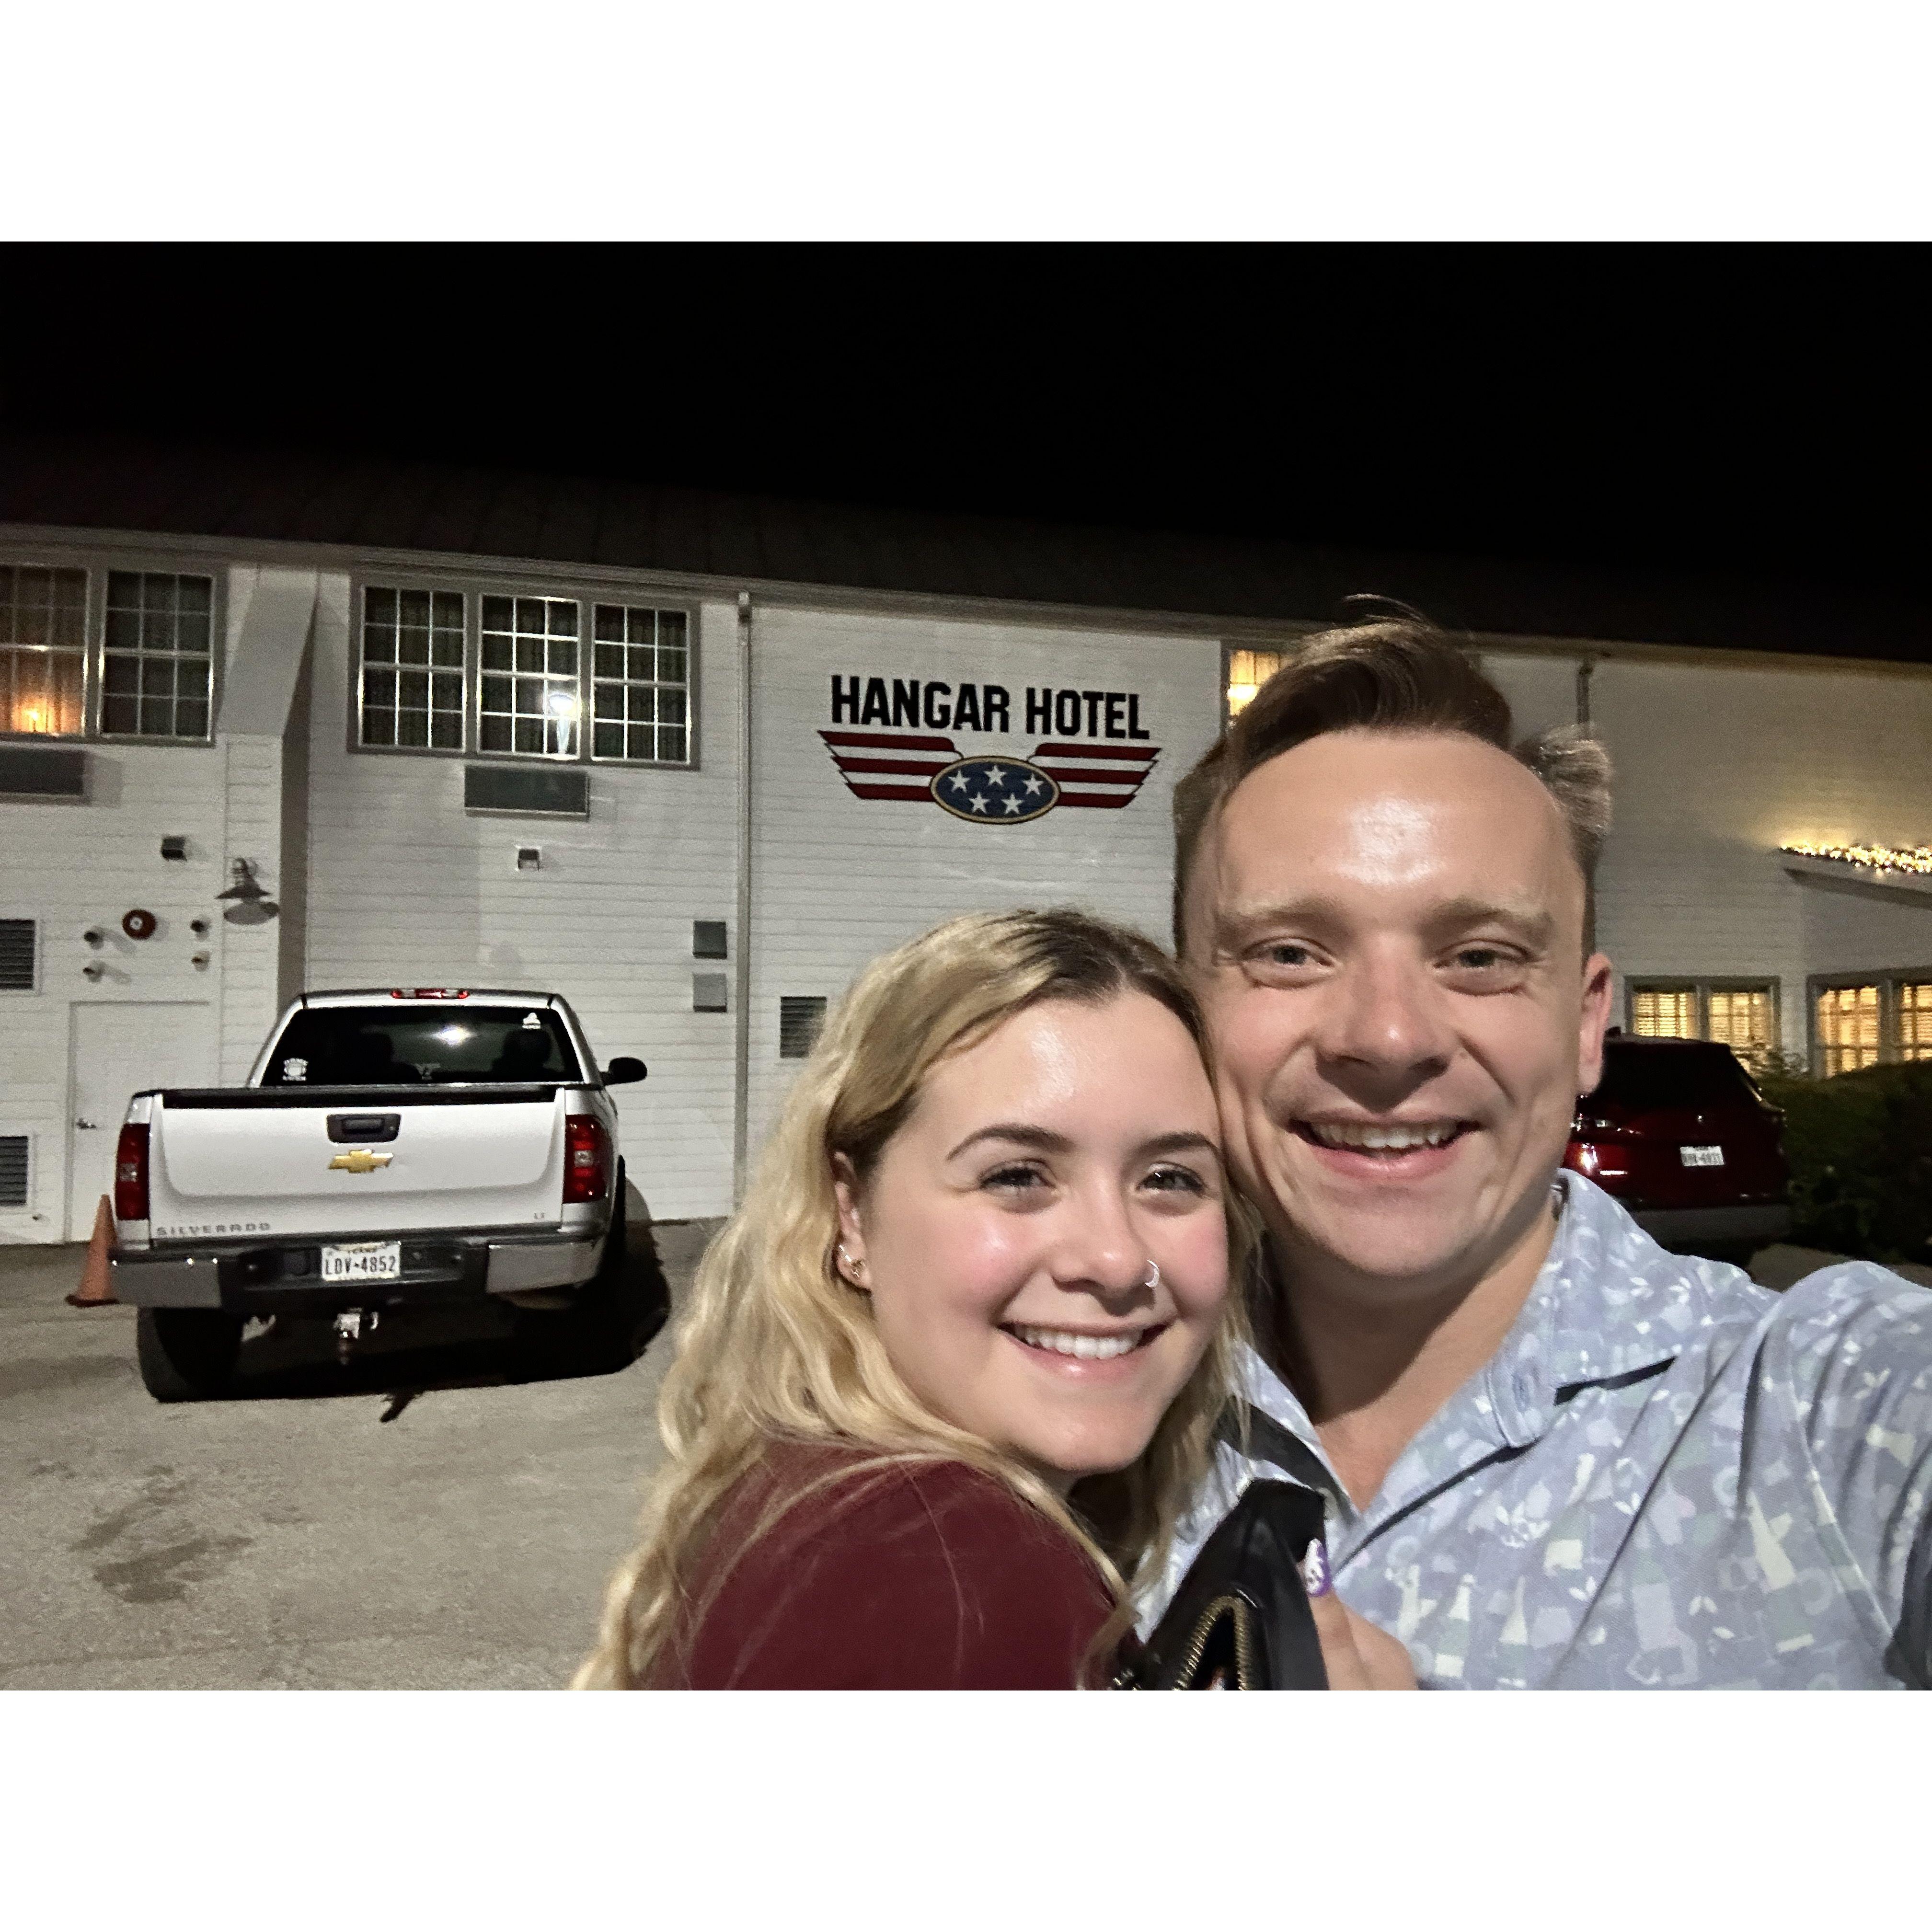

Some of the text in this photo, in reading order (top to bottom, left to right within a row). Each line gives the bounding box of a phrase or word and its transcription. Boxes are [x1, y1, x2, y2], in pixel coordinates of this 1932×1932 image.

[831, 674, 1150, 740] HANGAR HOTEL
[156, 1223, 271, 1235] SILVERADO
